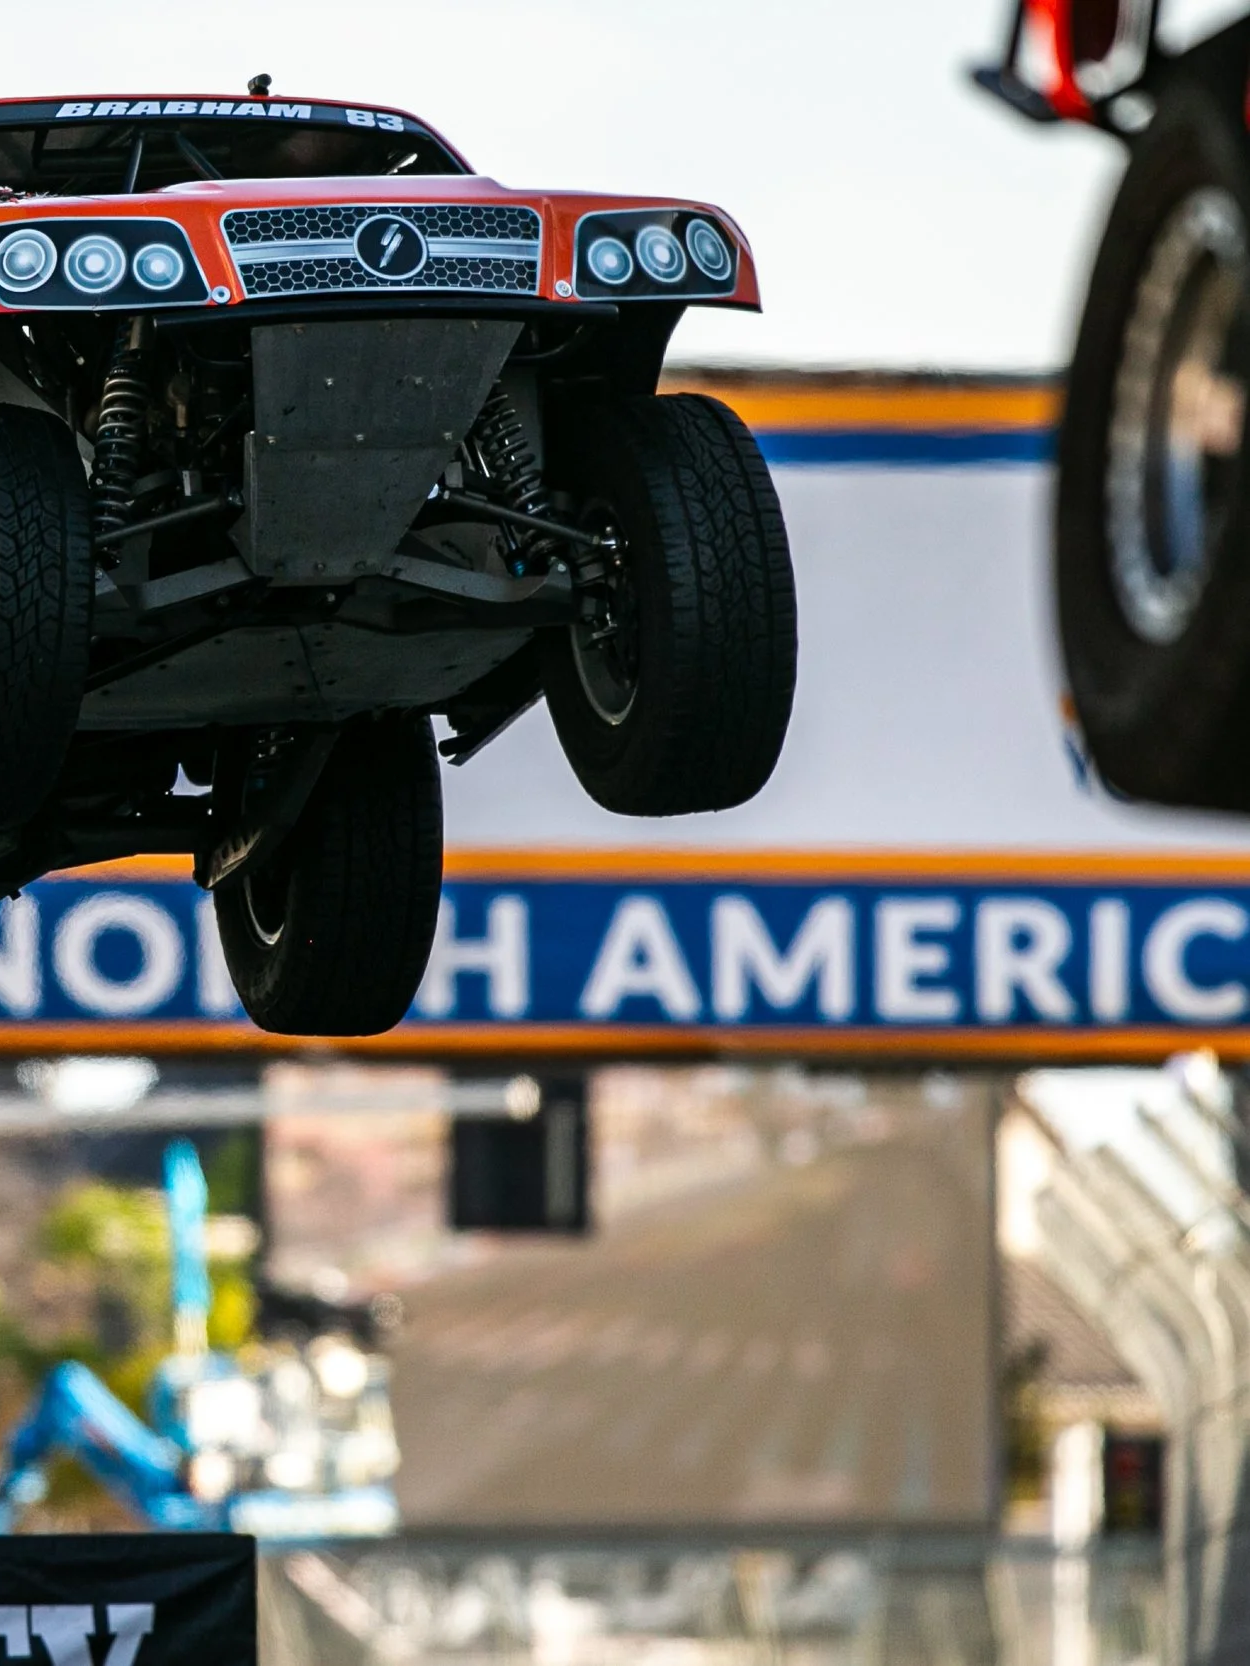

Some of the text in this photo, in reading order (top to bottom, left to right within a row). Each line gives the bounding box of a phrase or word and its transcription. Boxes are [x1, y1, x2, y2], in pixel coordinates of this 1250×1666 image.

[55, 101, 404, 132] BRABHAM 83
[579, 893, 1250, 1021] AMERIC
